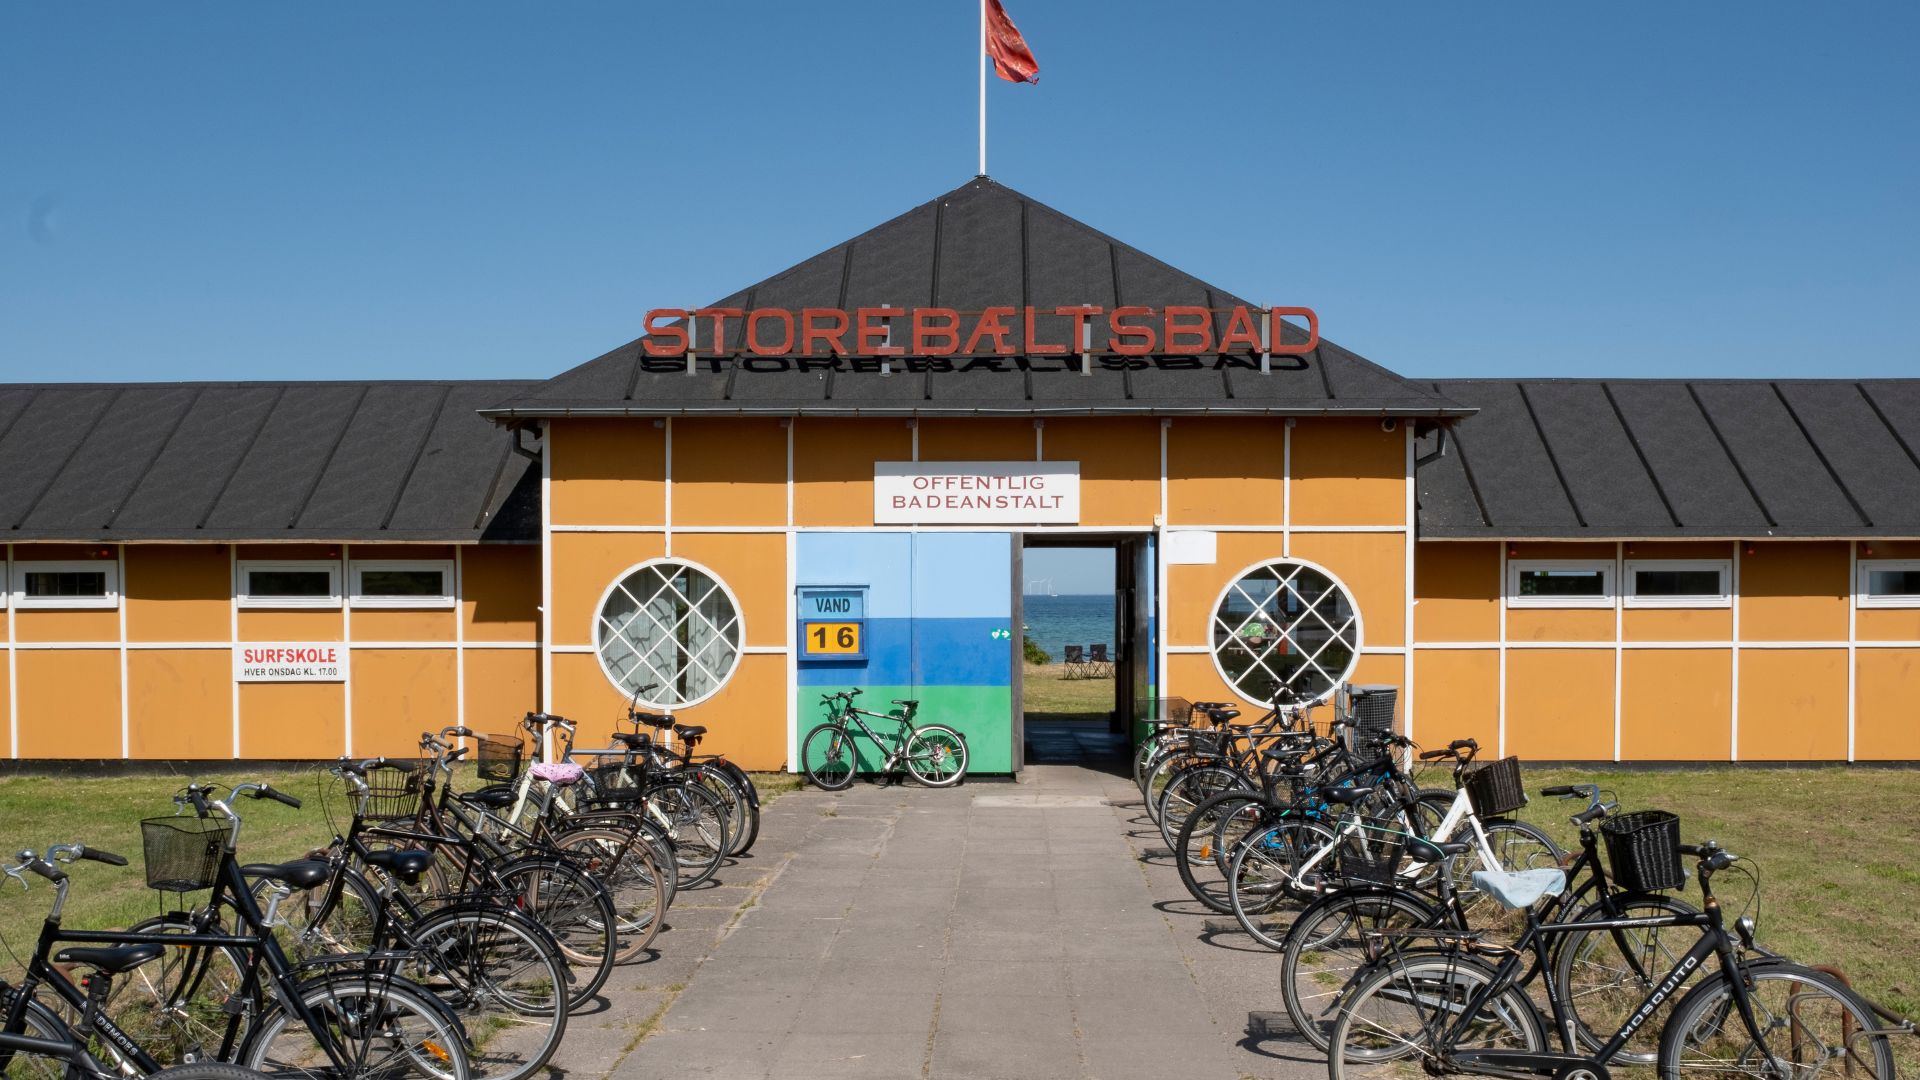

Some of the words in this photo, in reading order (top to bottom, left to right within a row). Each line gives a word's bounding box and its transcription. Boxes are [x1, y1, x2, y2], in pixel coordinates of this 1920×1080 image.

[642, 305, 1319, 356] STOREBÆLTSBAD
[912, 475, 1045, 490] OFFENTLIG
[892, 495, 1065, 509] BADEANSTALT
[815, 597, 851, 613] VAND
[813, 626, 855, 649] 16
[244, 648, 337, 663] SURFSKOLE
[244, 667, 266, 676] HVER
[268, 667, 302, 676] ONSDAG
[303, 667, 317, 676] KL.
[318, 667, 338, 676] 17.00
[1546, 971, 1558, 1002] MOSQUITO
[1620, 956, 1698, 1039] MOSQUITO
